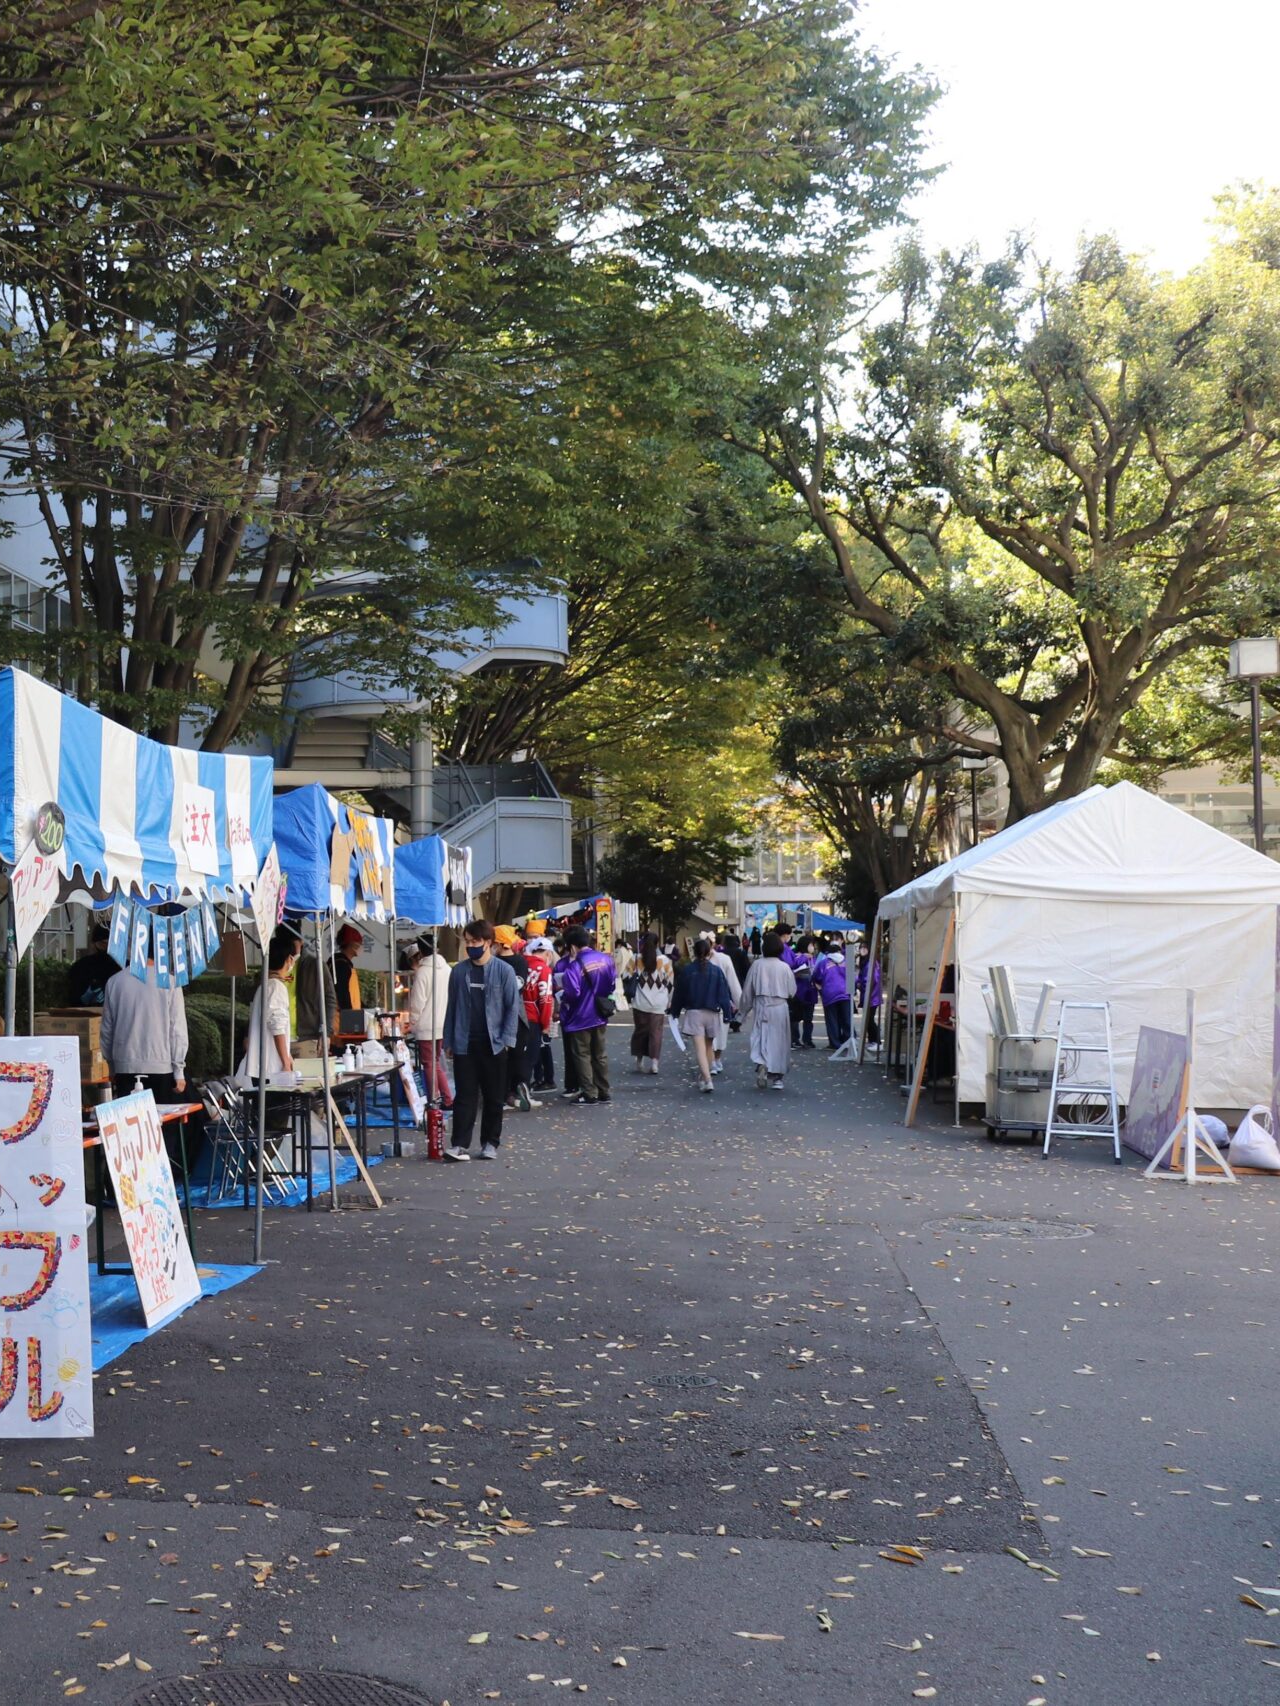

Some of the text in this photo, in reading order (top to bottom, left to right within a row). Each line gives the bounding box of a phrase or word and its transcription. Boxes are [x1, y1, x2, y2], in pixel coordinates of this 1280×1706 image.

[185, 803, 213, 848] 注文
[114, 902, 218, 974] FREENA
[103, 1110, 161, 1182] ワッフル
